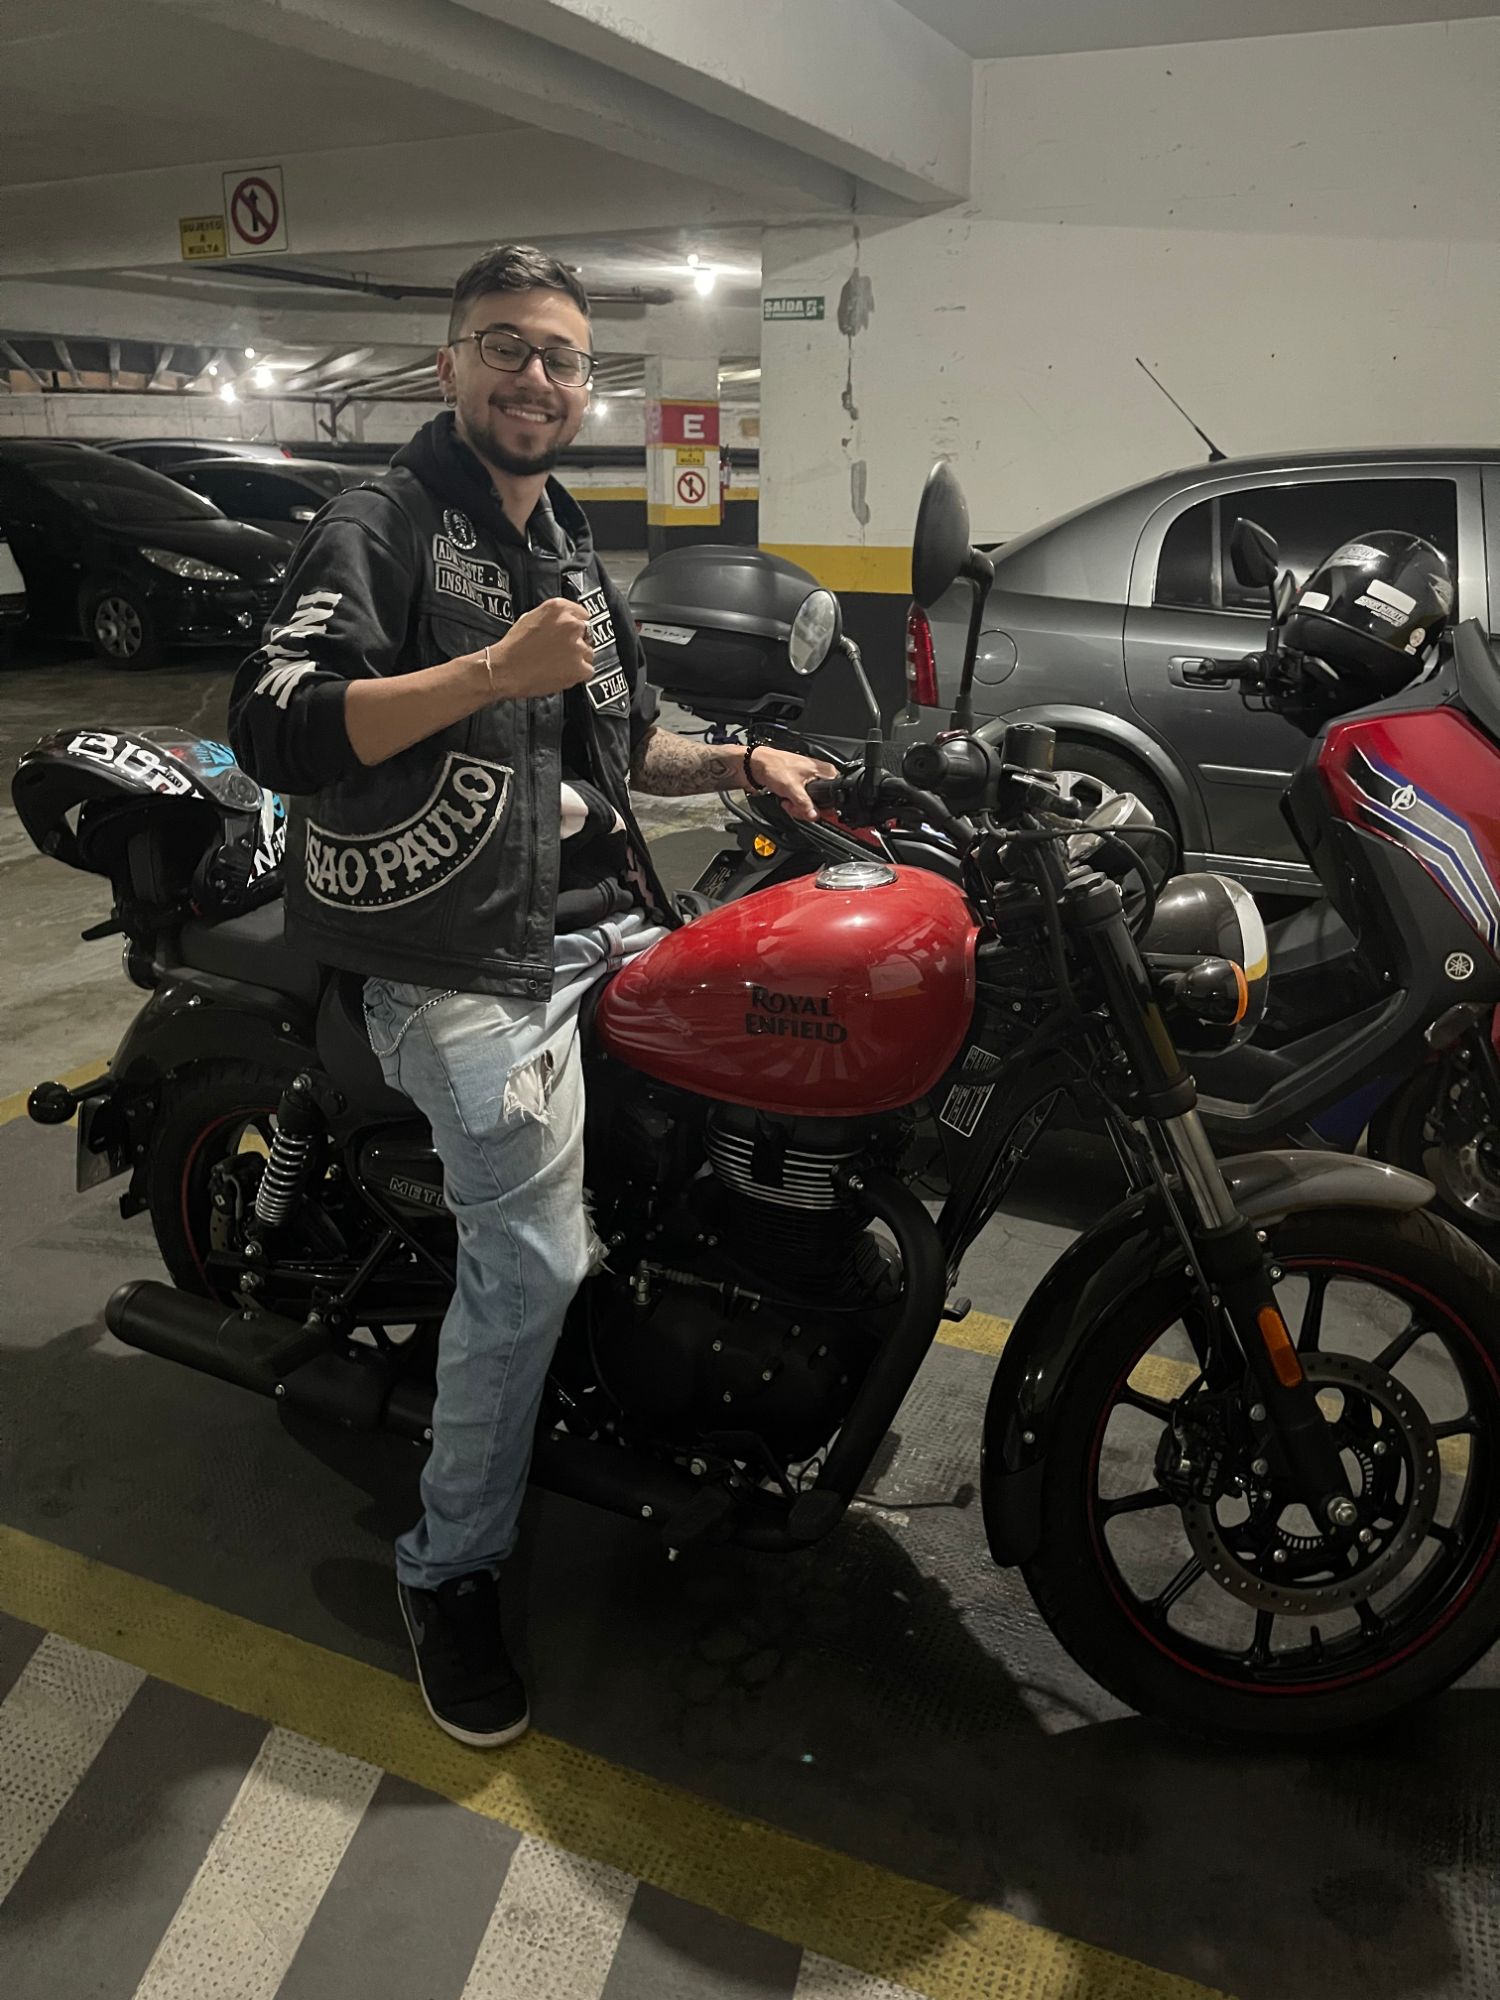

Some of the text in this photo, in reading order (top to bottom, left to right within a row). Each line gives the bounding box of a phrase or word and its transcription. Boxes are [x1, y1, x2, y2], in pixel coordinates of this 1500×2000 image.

[764, 299, 804, 312] SAÍDA
[683, 414, 705, 439] E
[369, 766, 496, 892] PAULO
[753, 986, 831, 1016] ROYAL
[746, 1014, 848, 1043] ENFIELD
